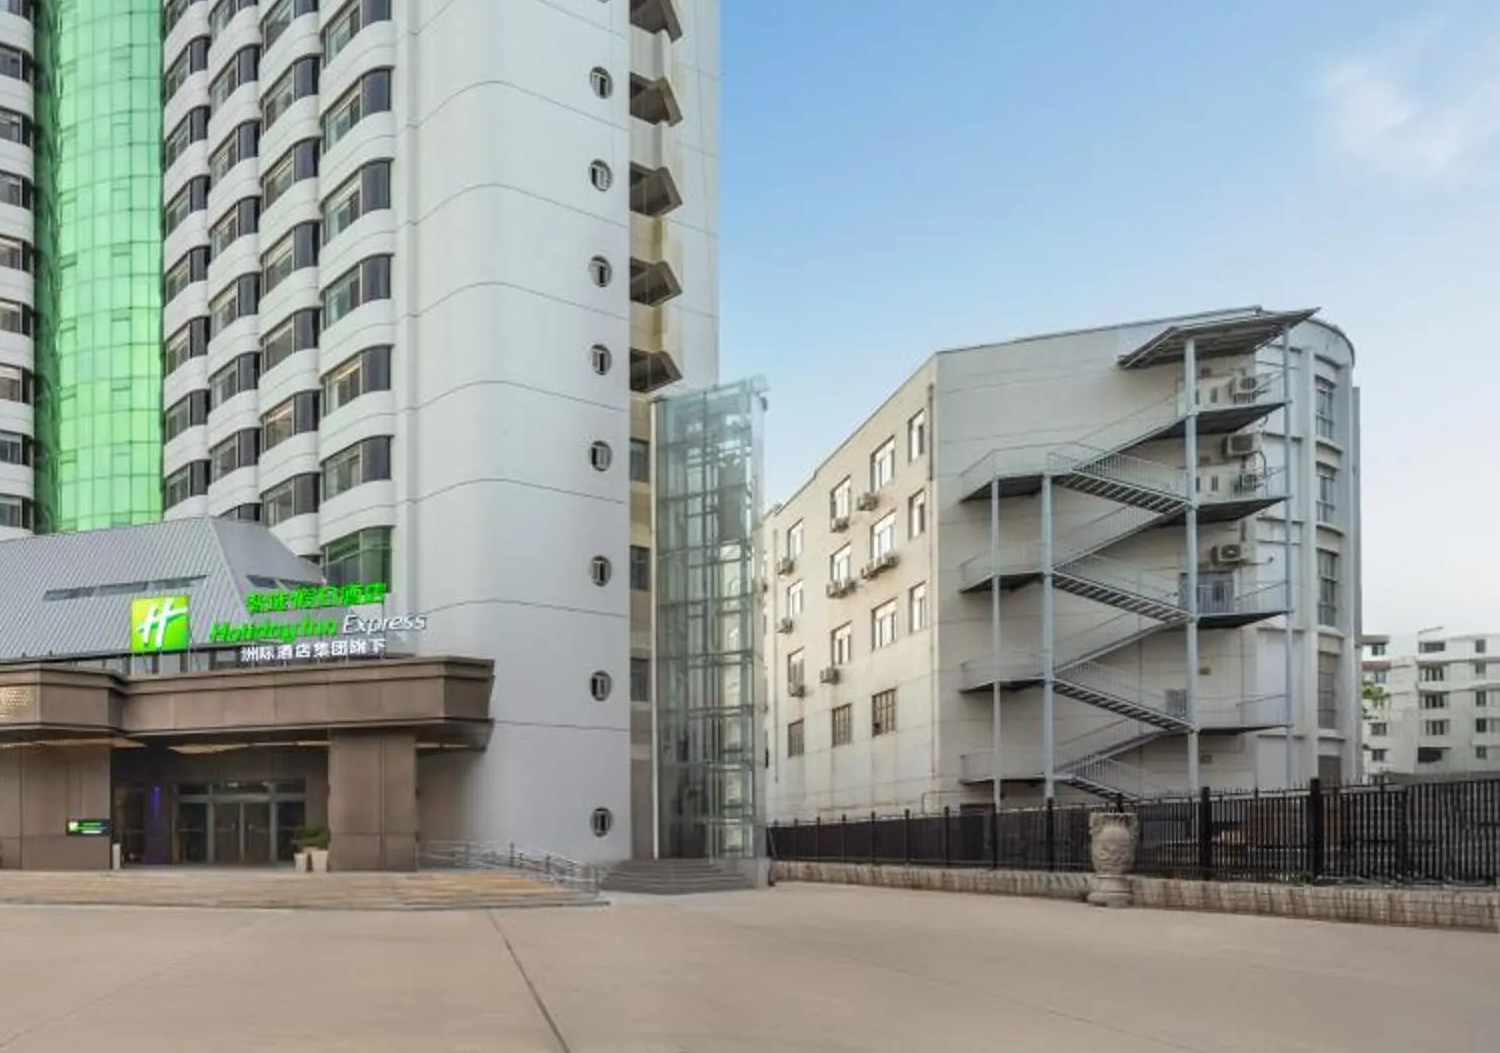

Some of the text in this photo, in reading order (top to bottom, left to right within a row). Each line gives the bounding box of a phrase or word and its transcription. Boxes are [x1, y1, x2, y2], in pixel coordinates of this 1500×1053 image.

[210, 618, 297, 644] Holiday
[342, 613, 426, 635] Express
[241, 638, 386, 662] 洲际酒店集团旗下
